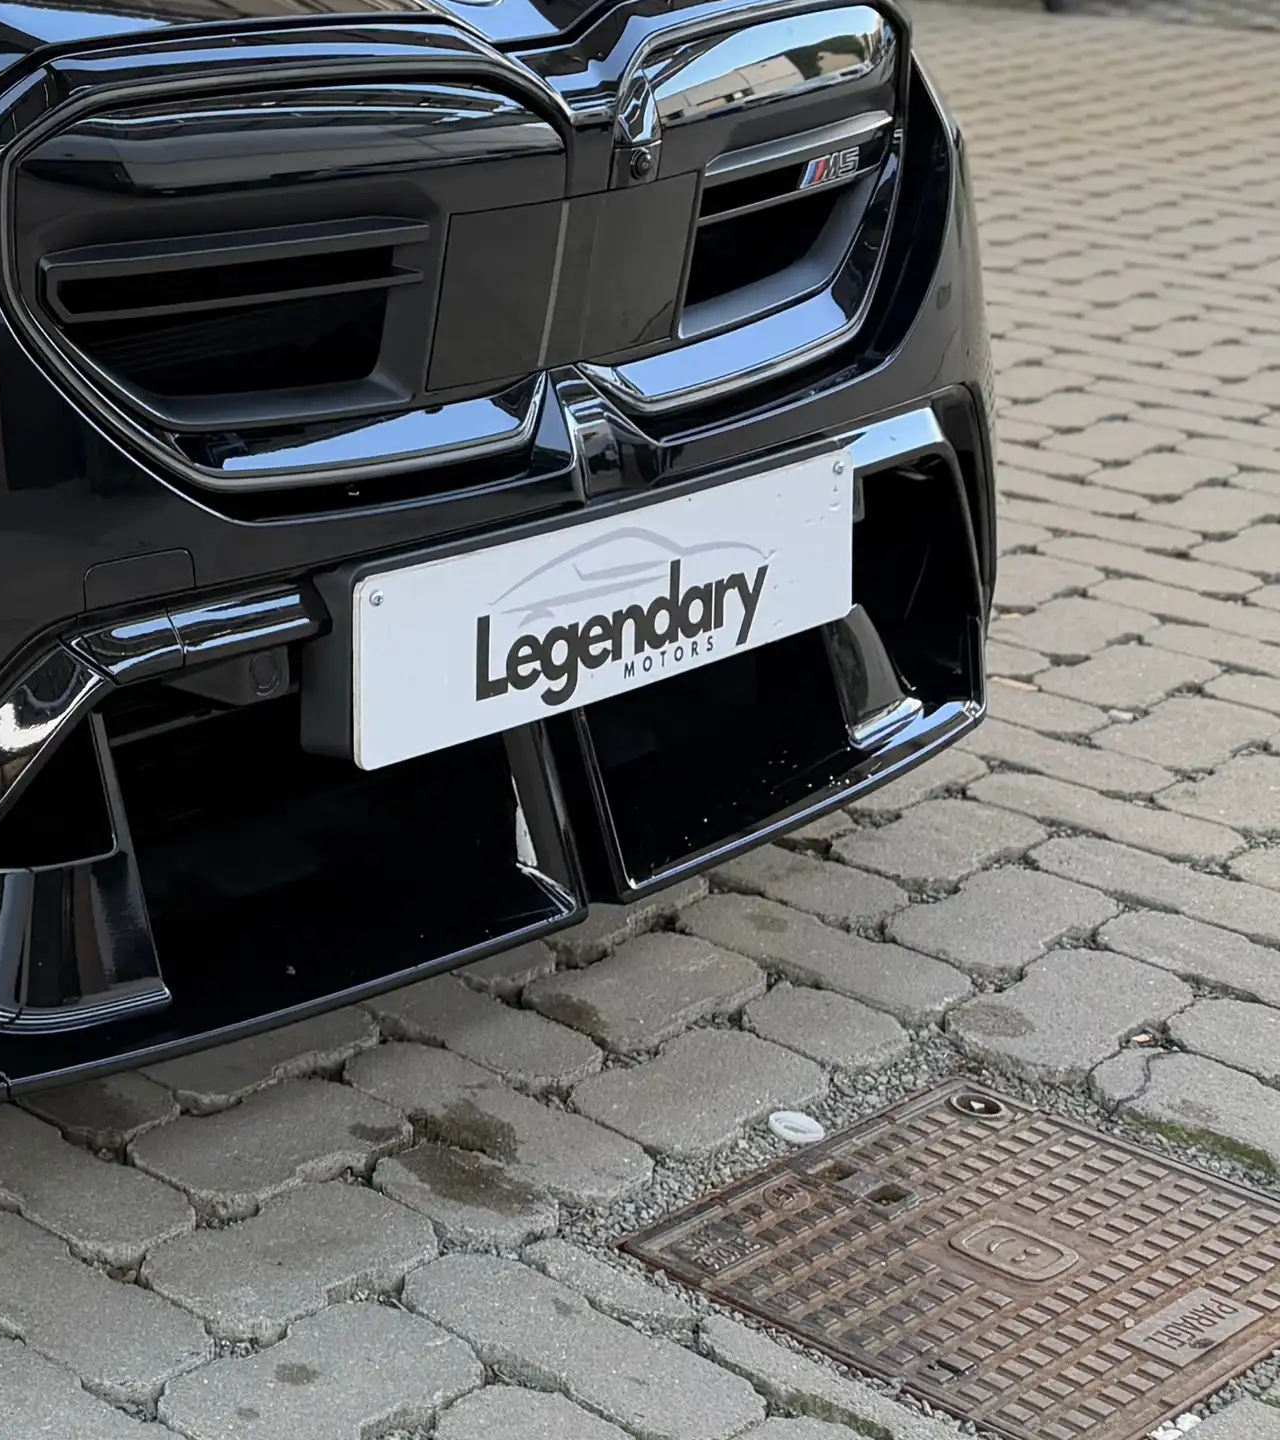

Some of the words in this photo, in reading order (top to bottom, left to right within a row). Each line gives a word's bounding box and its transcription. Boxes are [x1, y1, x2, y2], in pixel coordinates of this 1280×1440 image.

[810, 147, 859, 185] M5
[475, 559, 769, 707] Legendary
[623, 635, 715, 680] MOTORS
[1142, 1297, 1239, 1351] PARAGEL
